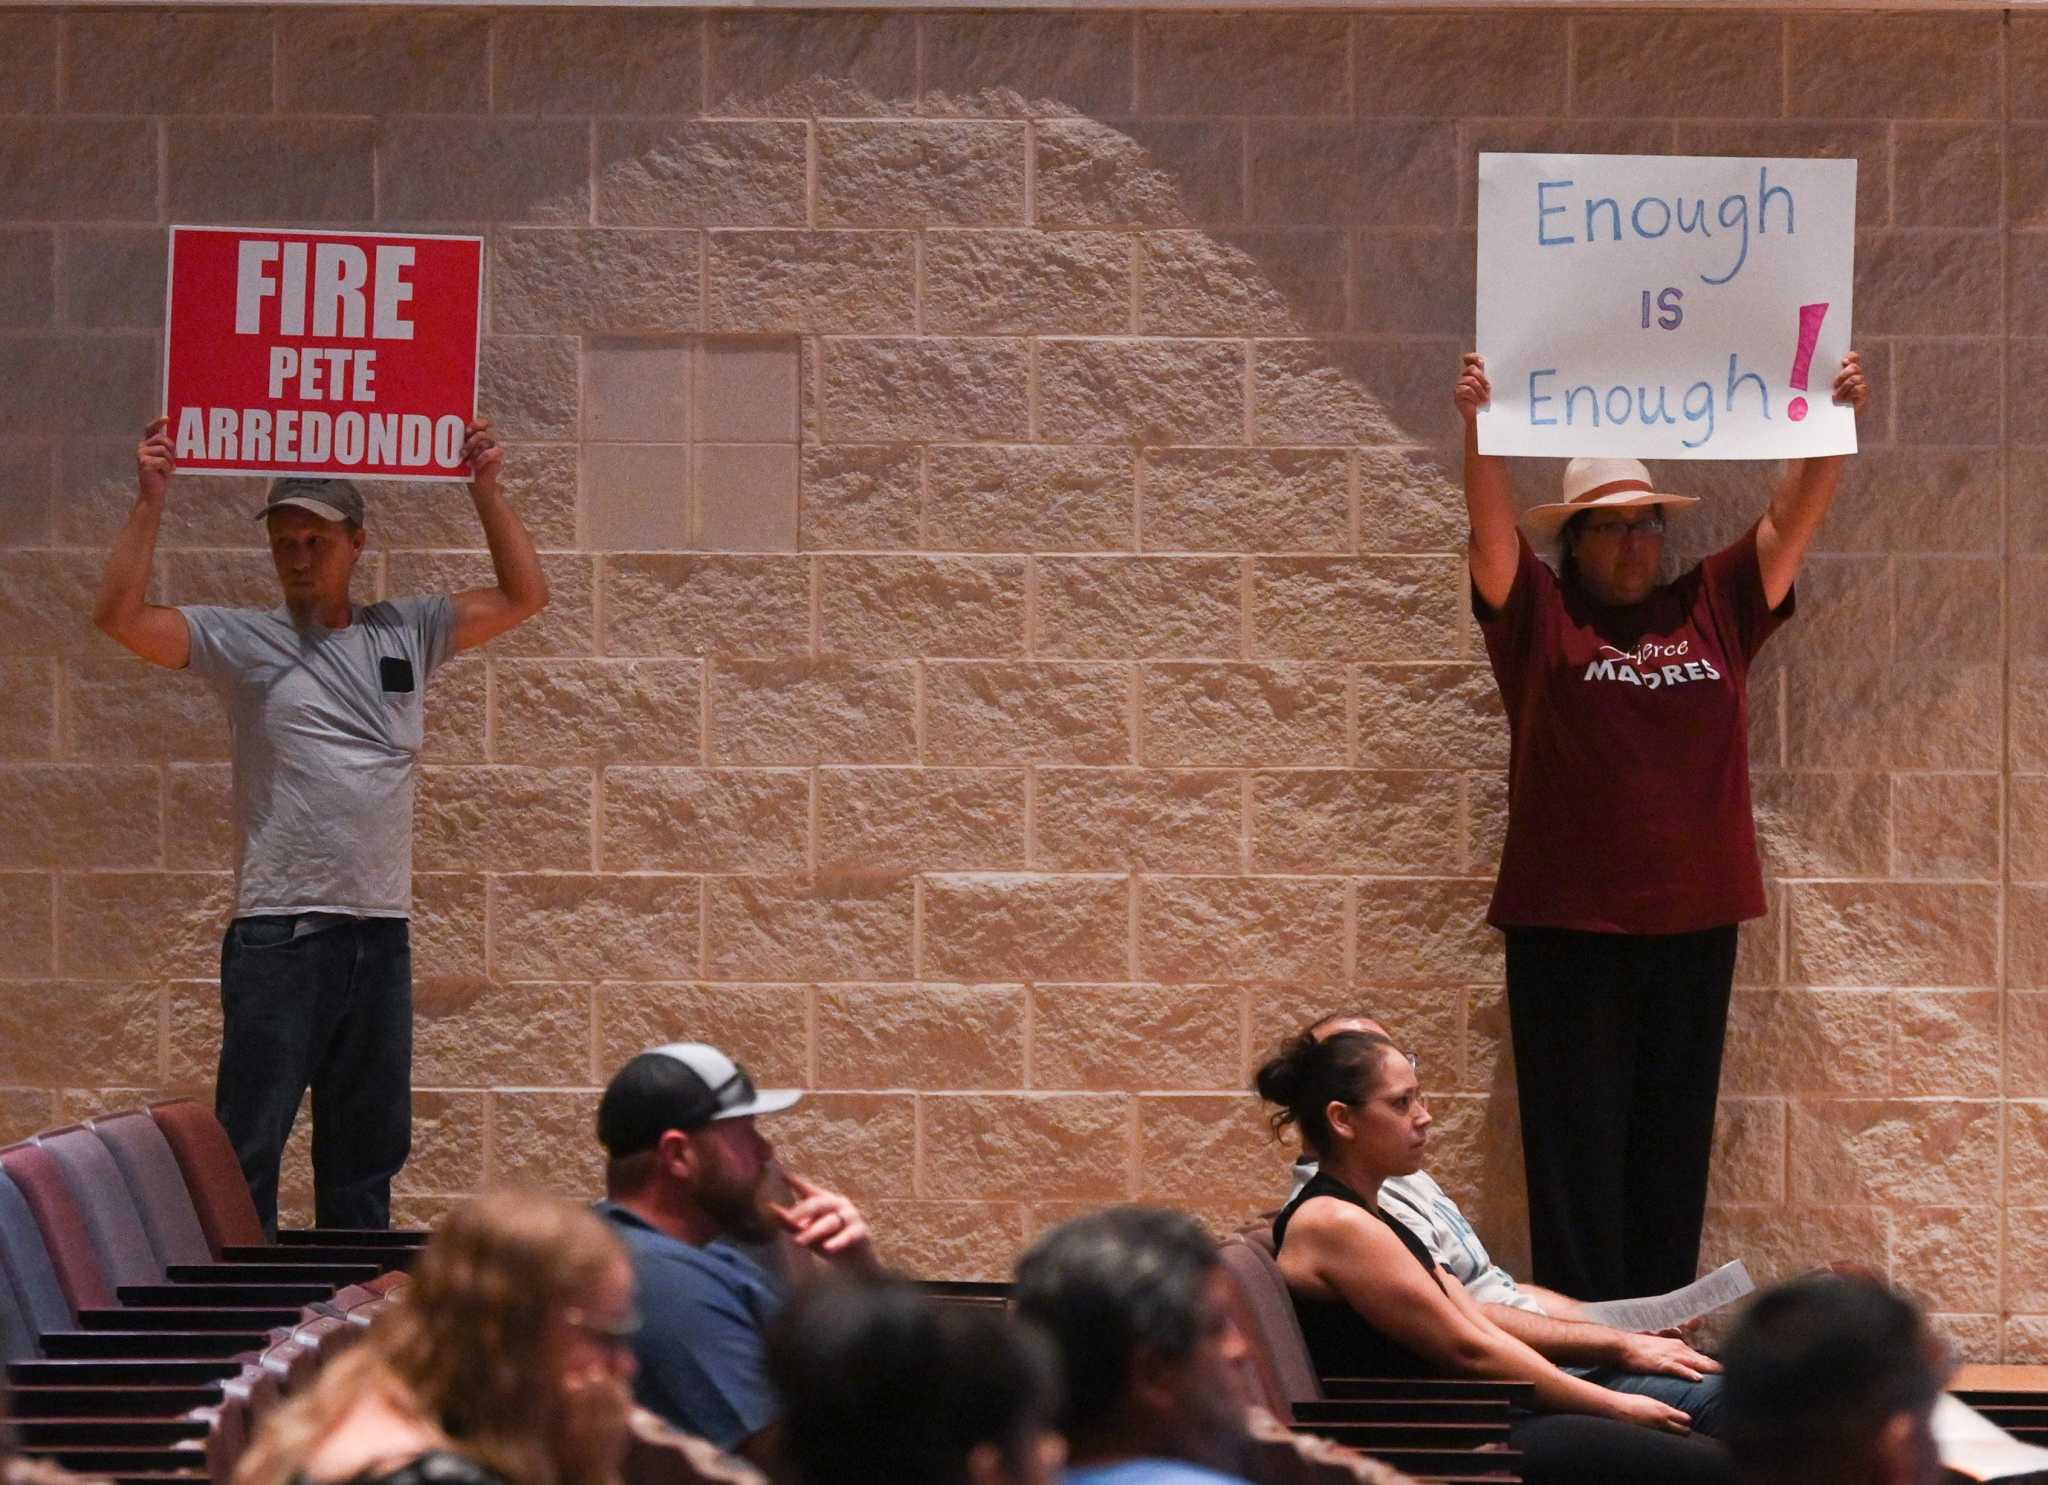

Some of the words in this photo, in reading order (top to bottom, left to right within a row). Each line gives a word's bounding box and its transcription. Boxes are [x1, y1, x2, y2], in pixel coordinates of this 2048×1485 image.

[1538, 167, 1795, 285] Enough
[235, 240, 416, 340] FIRE
[1641, 287, 1684, 330] IS
[268, 346, 377, 402] PETE
[175, 407, 466, 469] ARREDONDO
[1584, 658, 1721, 690] MADRES
